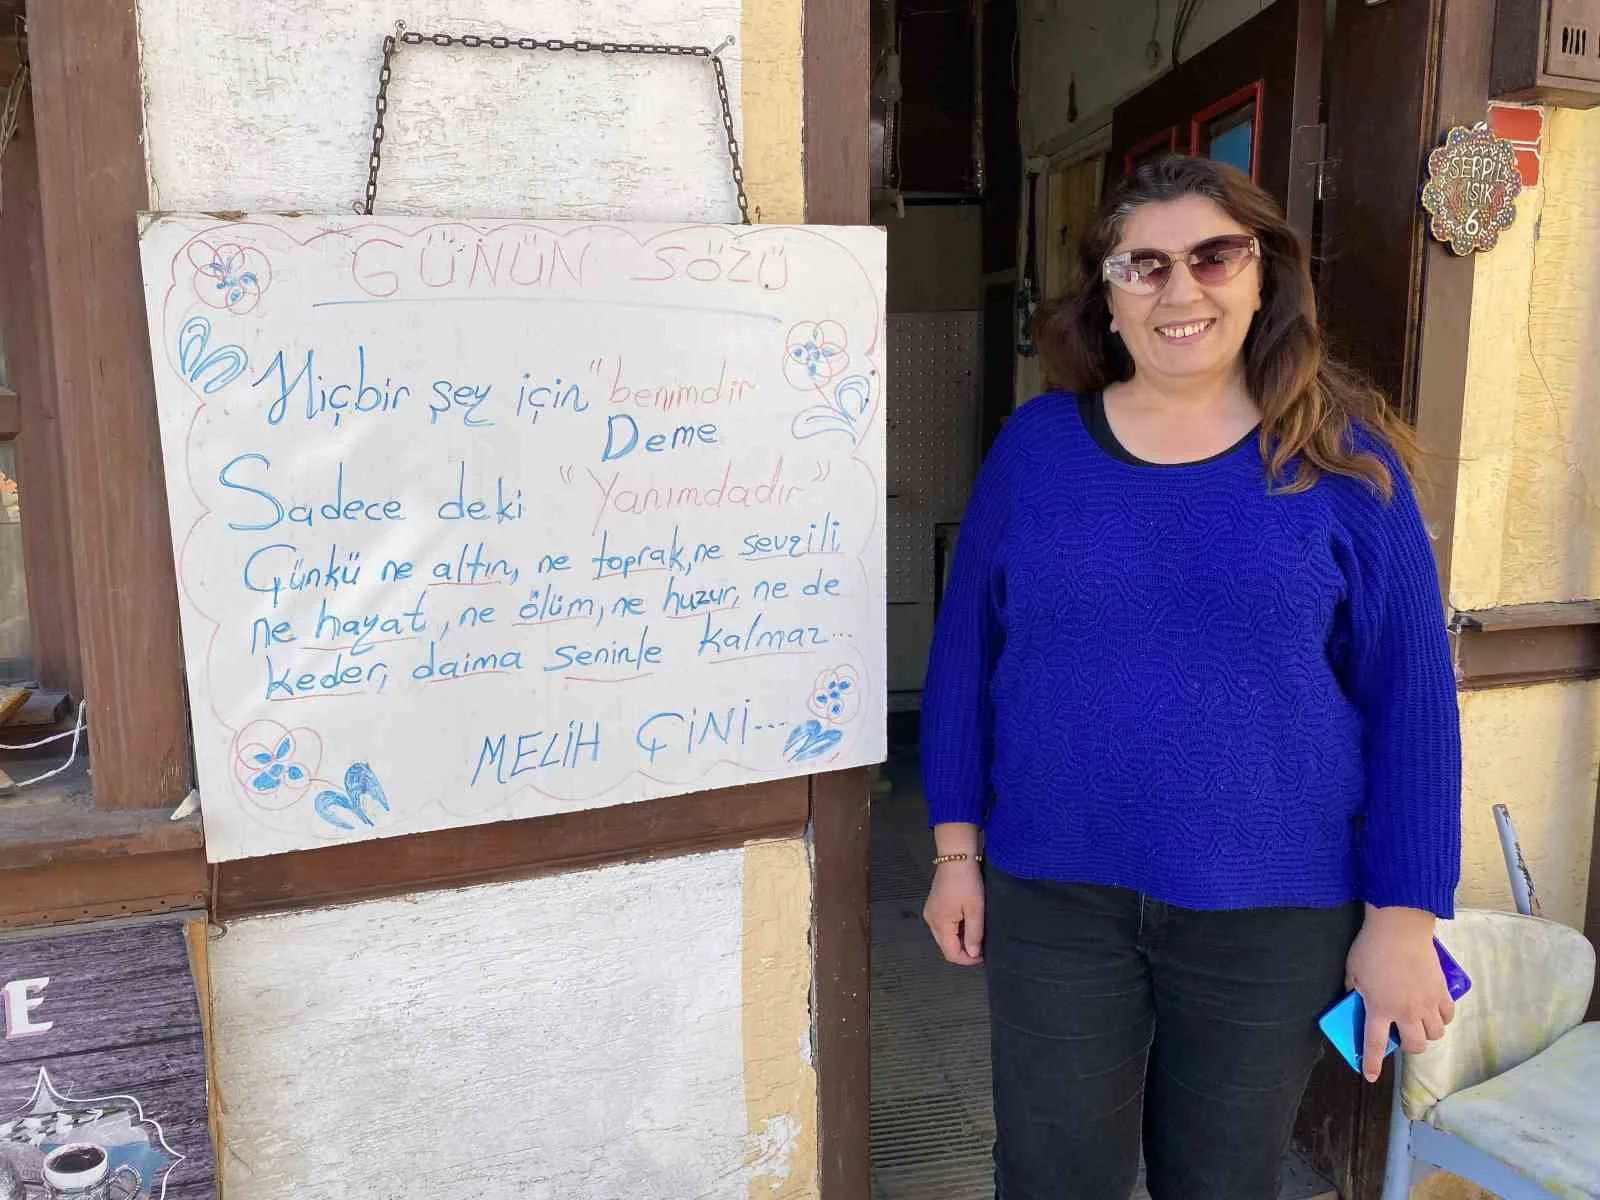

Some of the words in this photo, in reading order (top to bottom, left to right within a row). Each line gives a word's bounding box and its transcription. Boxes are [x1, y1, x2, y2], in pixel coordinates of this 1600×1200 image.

[1465, 208, 1479, 236] 6
[351, 231, 592, 298] GÜNÜN
[630, 240, 790, 290] SÖZÜ
[251, 345, 410, 426] Hiçbir
[429, 379, 495, 426] şey
[515, 373, 589, 424] için
[602, 413, 719, 462] Deme
[219, 453, 405, 531] Sadece
[244, 543, 363, 609] Çünkü
[381, 558, 414, 582] ne
[537, 553, 571, 574] ne
[250, 616, 297, 656] ne
[459, 604, 496, 626] ne
[611, 596, 646, 618] ne
[753, 579, 788, 600] ne
[803, 568, 841, 597] de
[412, 640, 522, 681] daima
[470, 718, 600, 787] MELİH
